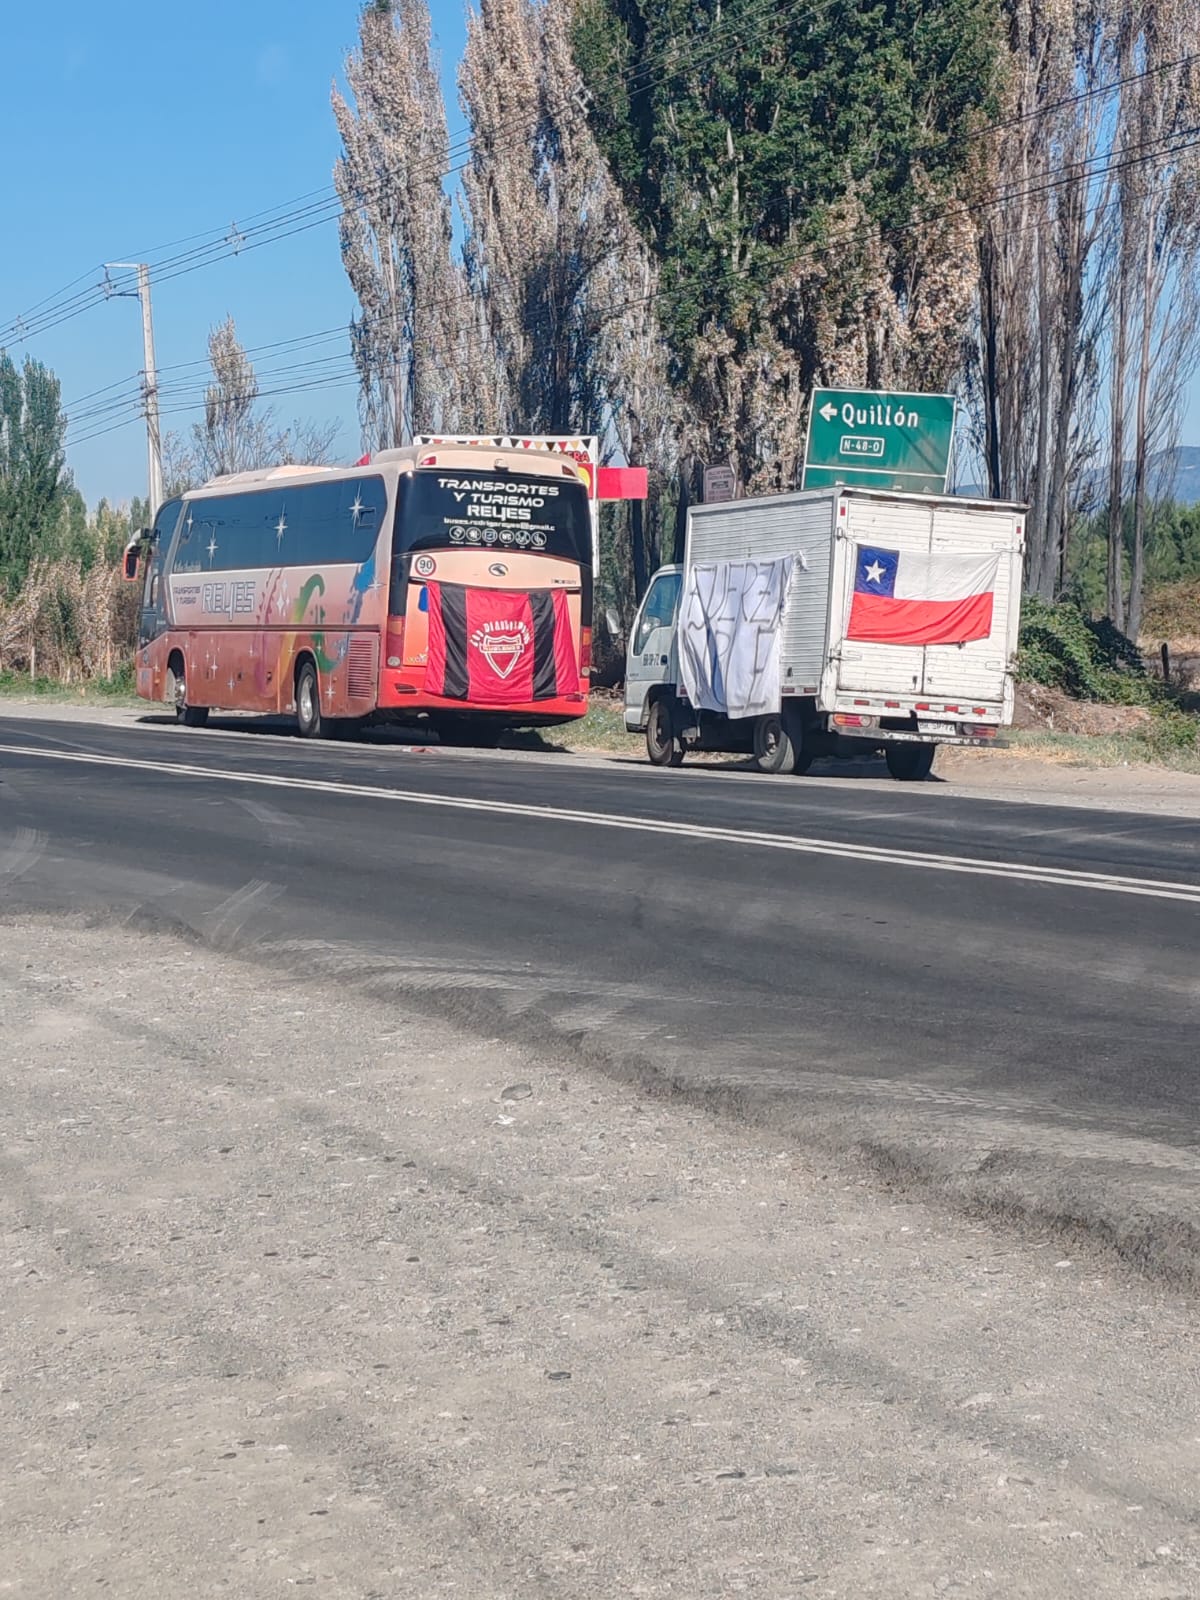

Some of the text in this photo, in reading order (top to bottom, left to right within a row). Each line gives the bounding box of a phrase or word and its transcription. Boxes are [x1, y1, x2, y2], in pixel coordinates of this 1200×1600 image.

[842, 403, 919, 428] Quillón
[438, 478, 559, 496] TRANSPORTES
[453, 491, 545, 508] Y TURISMO
[467, 504, 531, 521] REYES
[420, 559, 432, 569] 90
[202, 581, 256, 622] REYES
